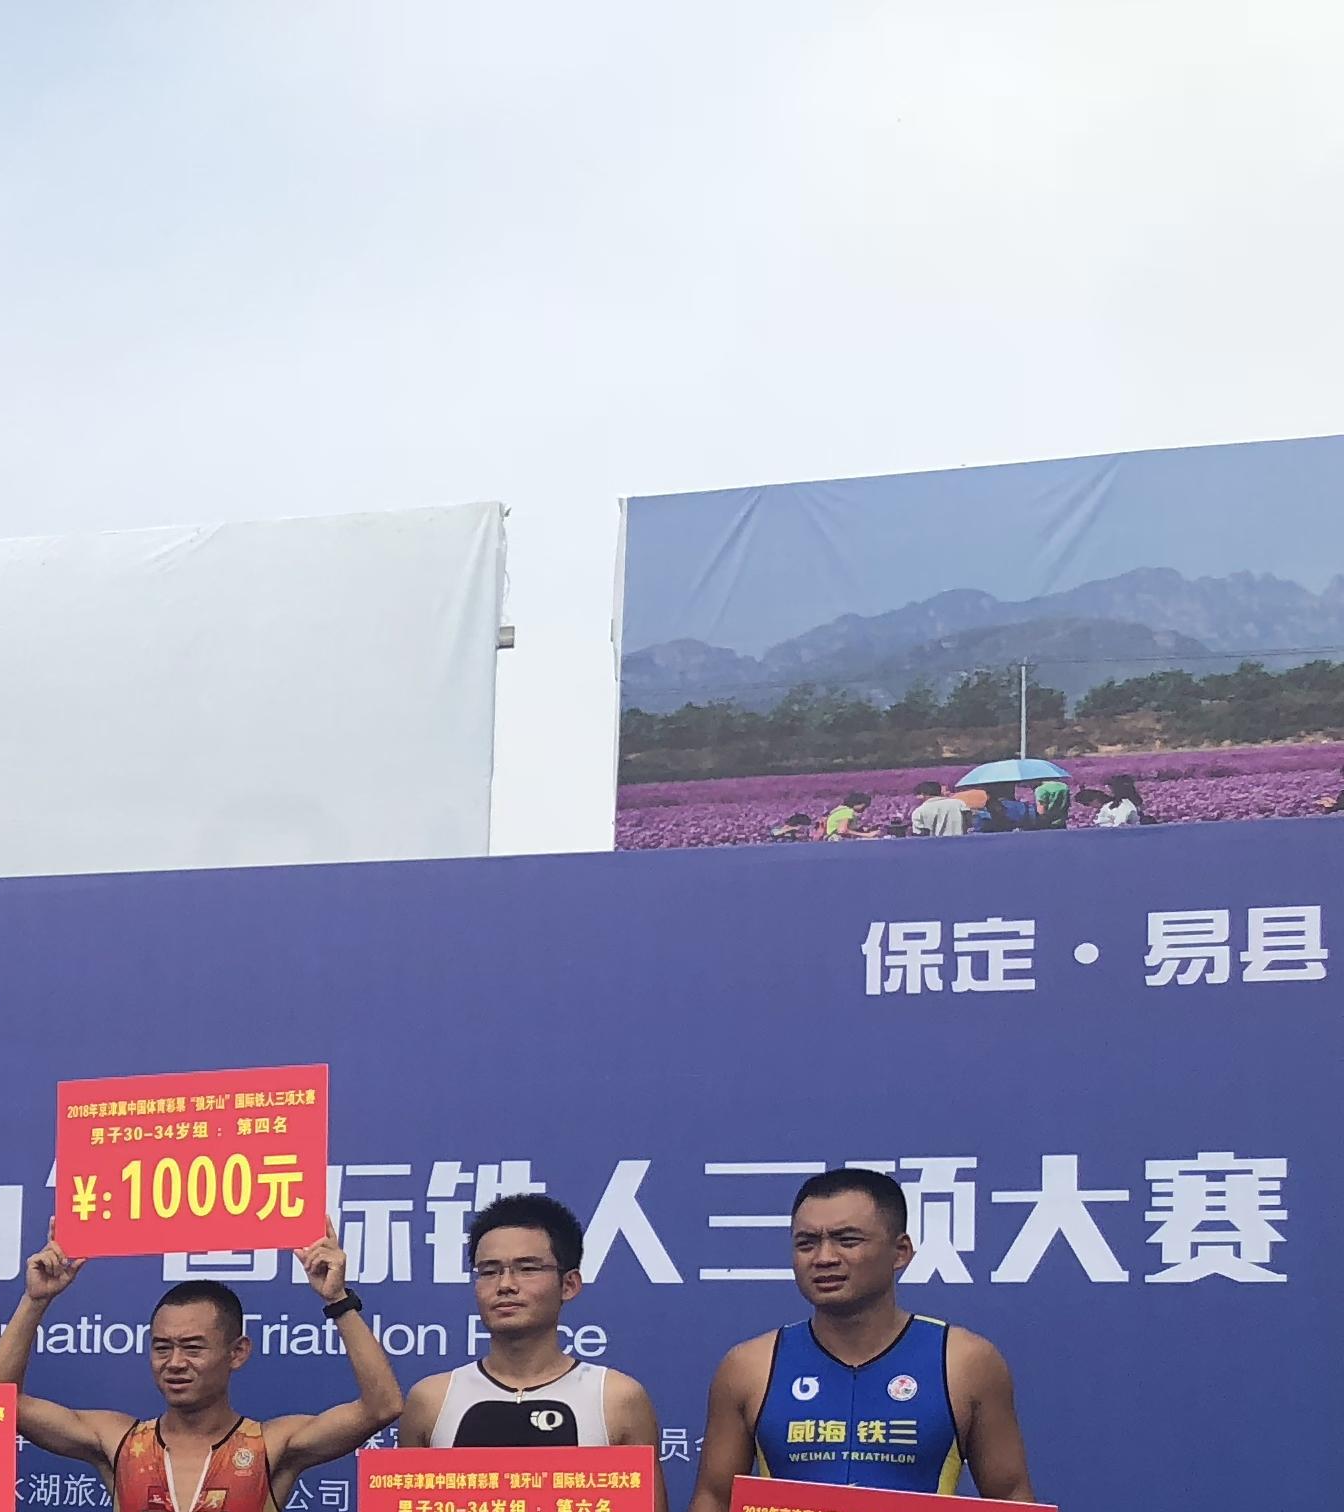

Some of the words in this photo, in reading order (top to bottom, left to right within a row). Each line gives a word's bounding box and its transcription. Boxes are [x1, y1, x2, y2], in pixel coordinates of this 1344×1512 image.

[236, 1115, 288, 1137] 第四名
[71, 1153, 305, 1222] ¥:1000元
[787, 1451, 836, 1463] WEIHAI
[842, 1450, 916, 1464] TRIATHLON
